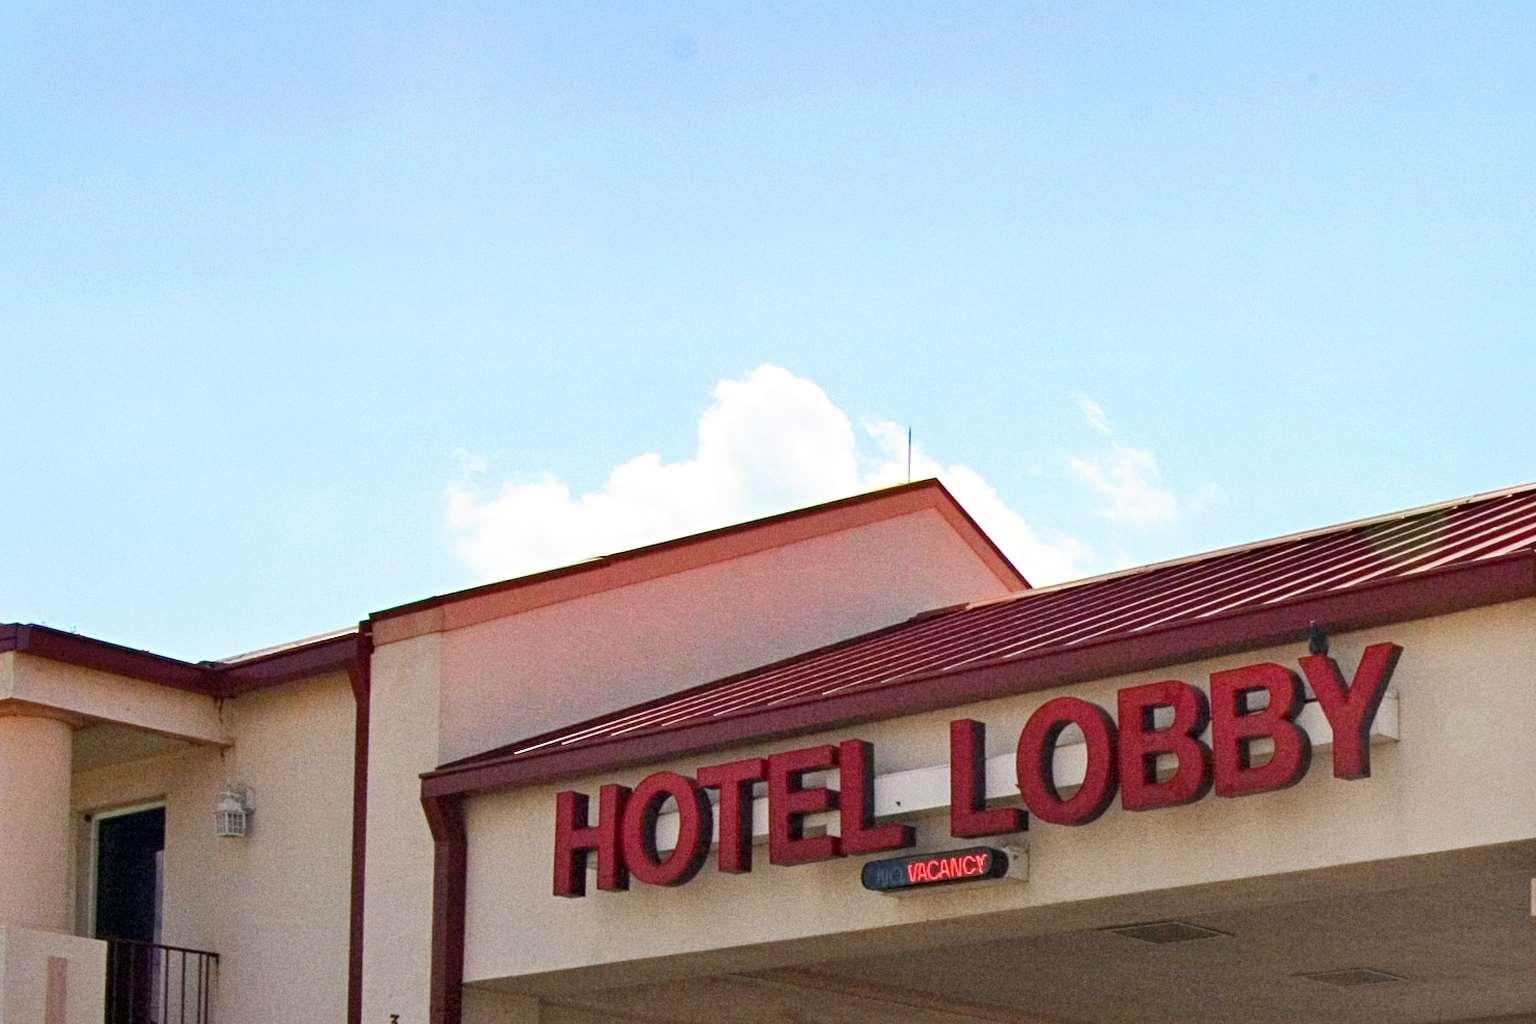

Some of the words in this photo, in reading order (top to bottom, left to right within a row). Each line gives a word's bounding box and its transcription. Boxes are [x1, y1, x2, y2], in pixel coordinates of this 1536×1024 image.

[553, 739, 914, 897] HOTEL
[950, 641, 1403, 838] LOBBY
[907, 853, 988, 882] VACANCY
